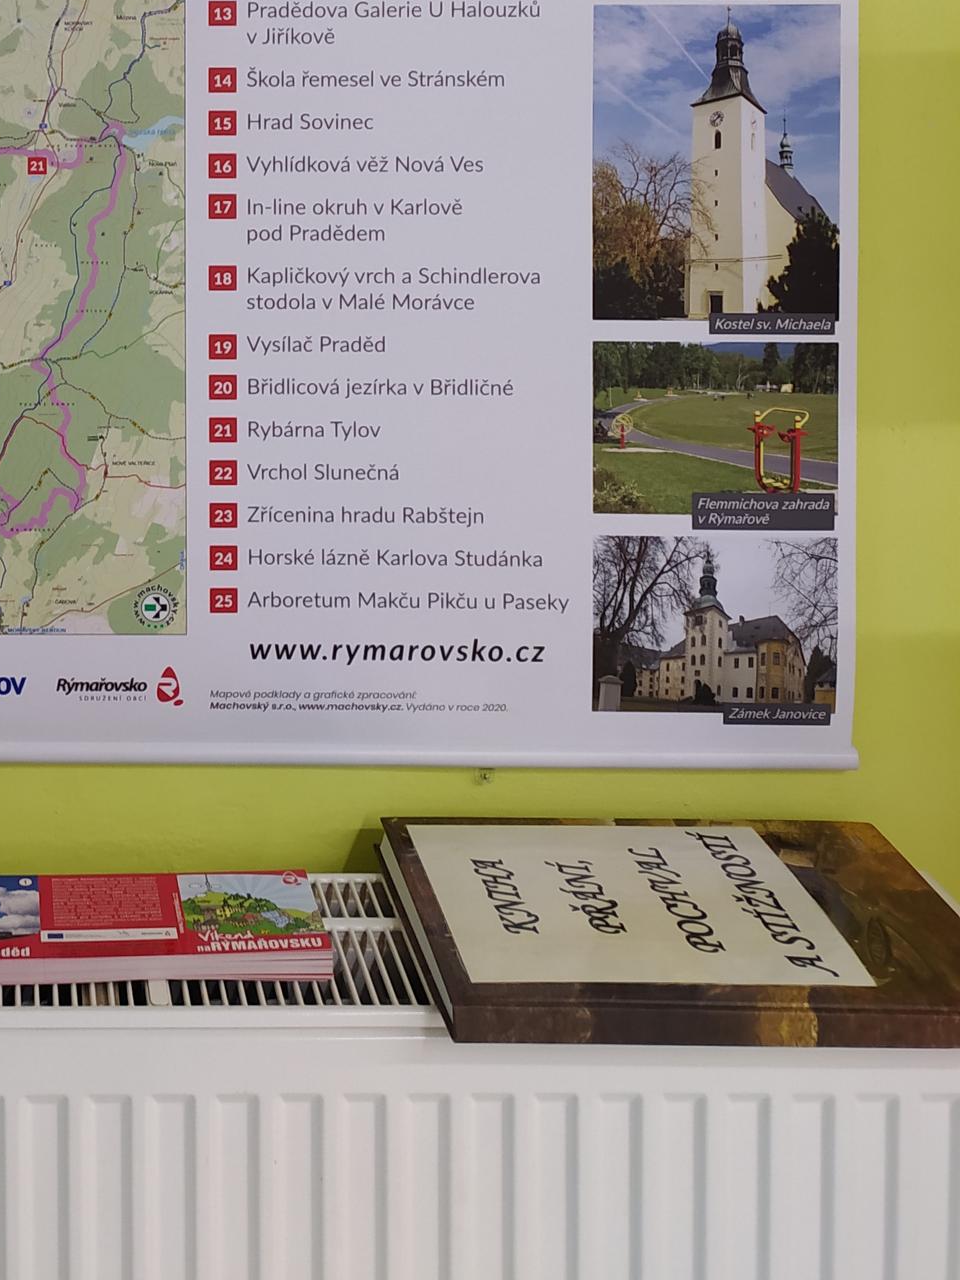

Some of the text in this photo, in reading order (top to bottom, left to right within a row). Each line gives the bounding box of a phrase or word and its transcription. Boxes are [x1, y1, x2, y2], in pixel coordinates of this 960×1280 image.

[248, 1, 540, 18] Pradědova Galerie U Halouzků
[247, 67, 504, 87] Škola řemesel ve Stránském
[248, 114, 373, 130] Hrad Sovinec
[247, 156, 483, 176] Vyhlídková věž Nová Ves
[248, 198, 462, 215] In-line okruh v Karlově
[248, 224, 384, 244] pod Pradědem
[248, 267, 540, 287] Kapličkový vrch a Schindlerova
[247, 293, 474, 310] stodola v Malé Morávce
[715, 318, 831, 330] Kostel sv. Michaela
[247, 336, 385, 355] Vysílač Praděd
[248, 378, 513, 398] Břidlicová jezírka v Břidličné
[248, 421, 380, 441] Rybárna Tylov
[247, 464, 398, 480] Vrchol Slunečná
[698, 498, 829, 509] Flemmichova zahrada
[248, 506, 483, 527] Zřícenina hradu Rabštejn
[698, 513, 769, 526] v Rýmařově
[249, 549, 542, 567] Horské lázně Karlova Studánka
[248, 591, 569, 613] Arboretum Makču Pikču u Paseky
[250, 639, 545, 665] www.rymarovsko.cz
[56, 676, 147, 694] Rýmařovsko
[729, 708, 826, 720] Zámek Janovice
[470, 858, 540, 935] KNIHA
[627, 847, 726, 954] POCHVAL
[685, 831, 839, 978] A STÍŽNOSTÍ
